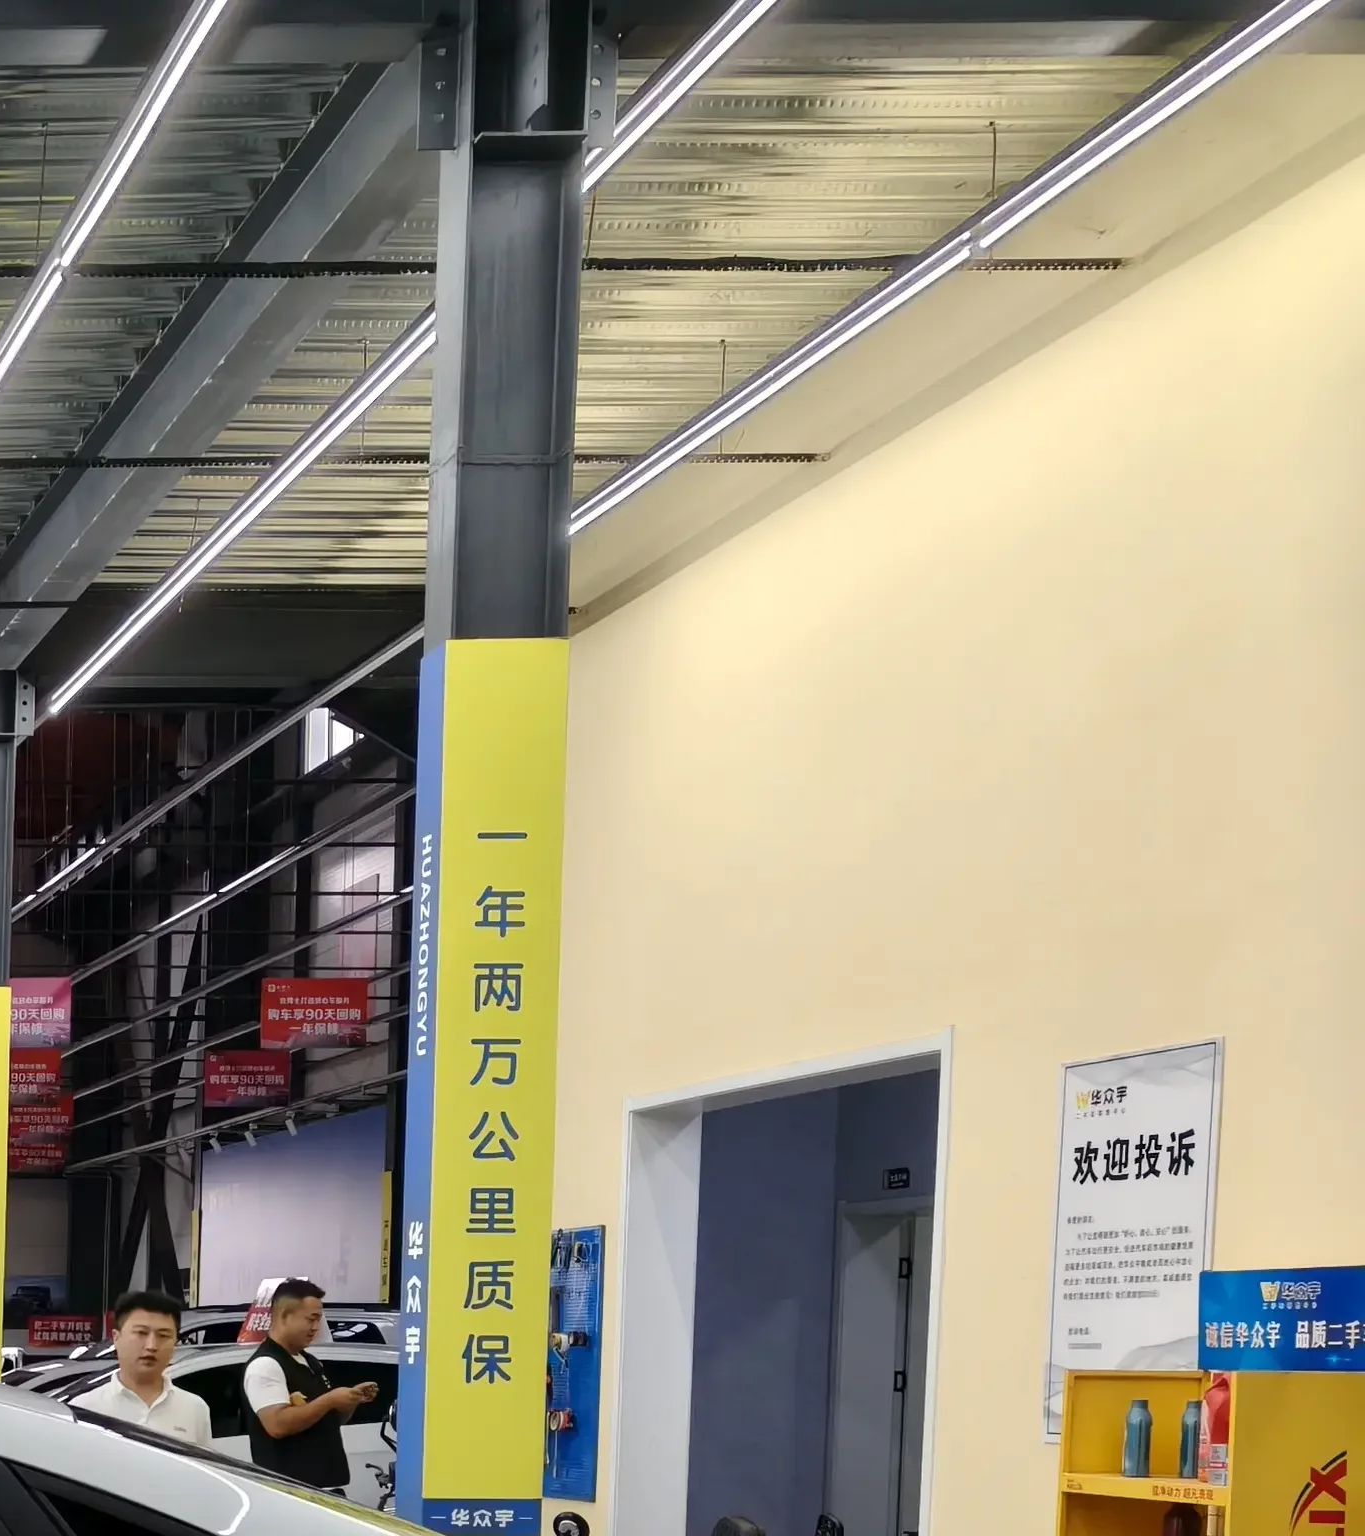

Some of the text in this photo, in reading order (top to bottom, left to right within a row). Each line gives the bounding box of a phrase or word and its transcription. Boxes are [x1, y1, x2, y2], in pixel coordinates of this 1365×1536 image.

[416, 833, 433, 1057] HUAZHONGYU
[267, 1008, 362, 1021] 购车享90天回购
[209, 1074, 285, 1085] 购车享90天回购
[462, 831, 528, 1385] 一年两万公里质保
[1091, 1086, 1128, 1106] 华众宇
[1073, 1128, 1196, 1185] 欢迎投诉
[405, 1220, 424, 1365] 华众宇
[1205, 1320, 1365, 1350] 诚信华众宇 品质二手
[450, 1508, 515, 1528] 华众宇
